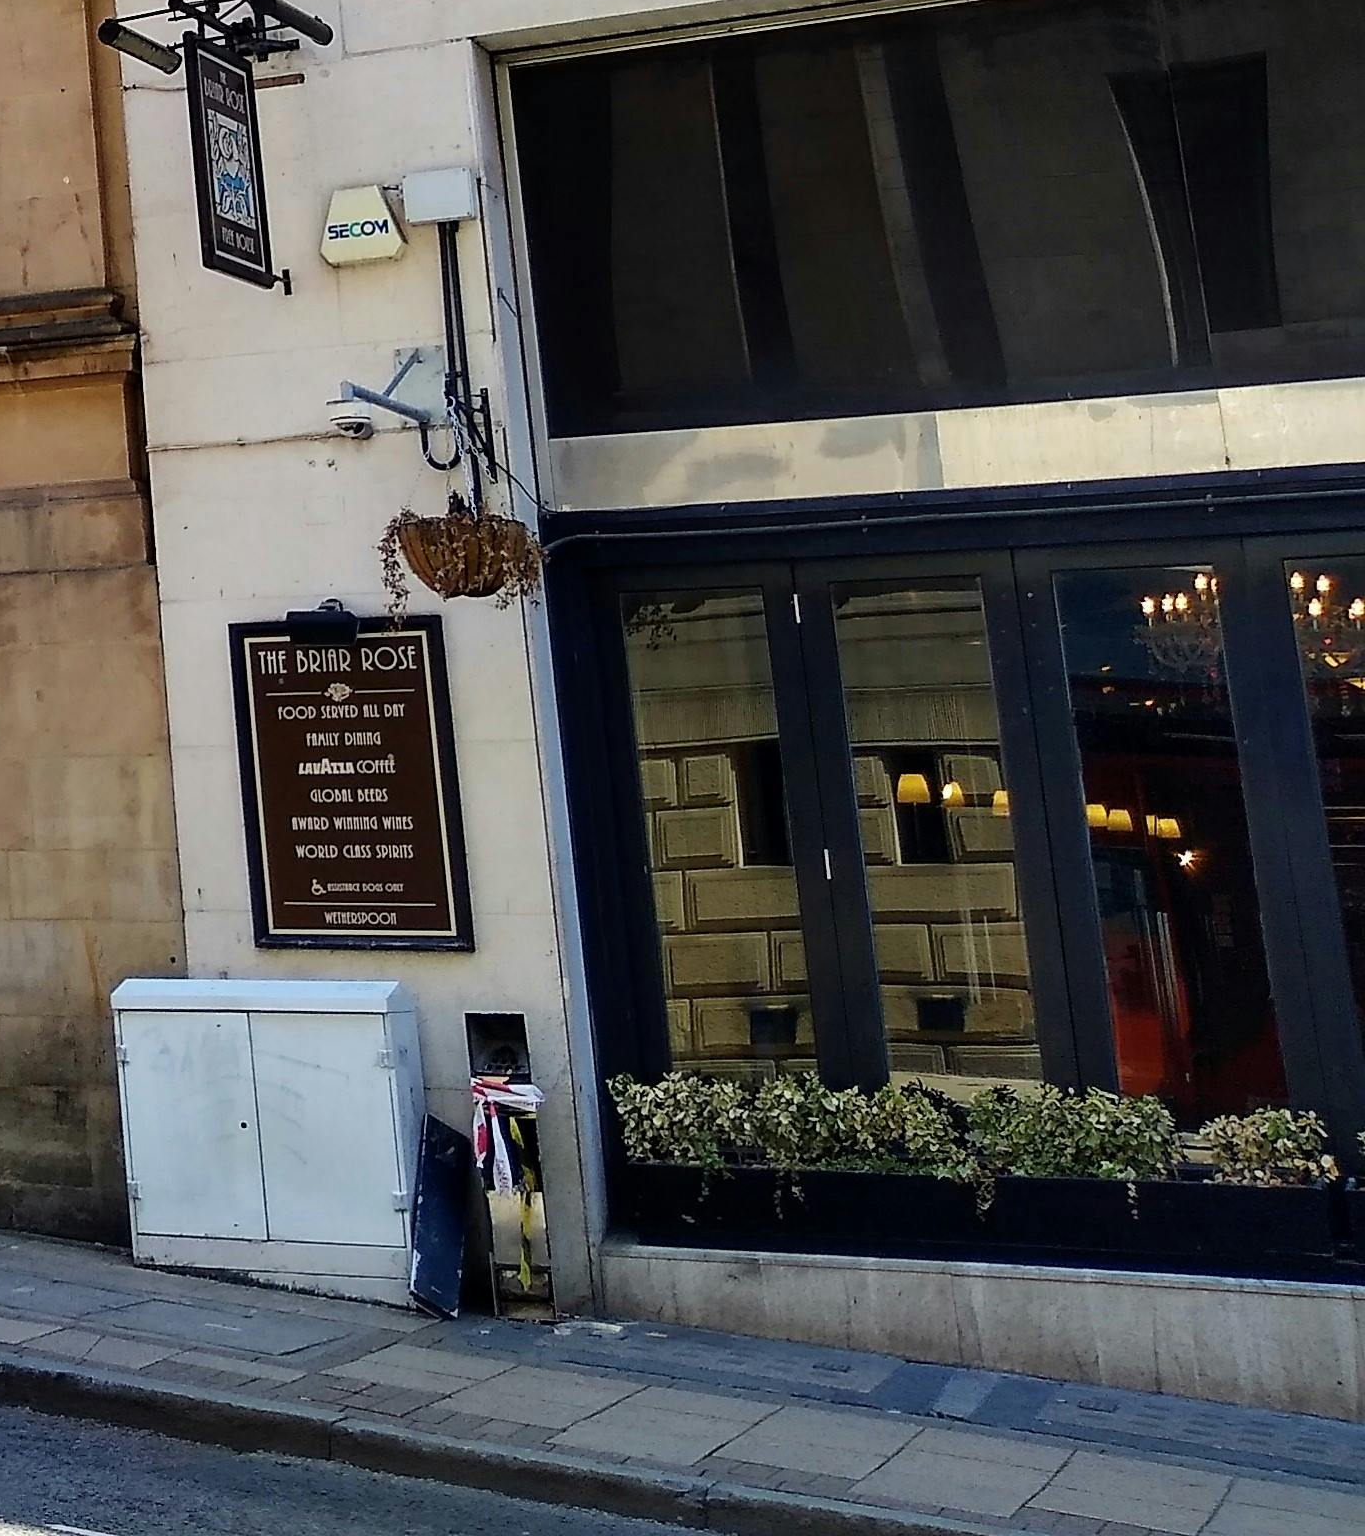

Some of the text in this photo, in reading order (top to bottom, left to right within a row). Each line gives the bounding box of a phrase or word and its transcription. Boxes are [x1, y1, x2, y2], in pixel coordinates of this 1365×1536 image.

[328, 219, 389, 240] SECOM
[257, 645, 418, 674] THE BRIAR ROSE
[277, 703, 405, 720] FOOD SERVED ALL DAY
[306, 731, 382, 747] FAMILY DINING
[298, 758, 396, 775] LAVAZZA COFFEE
[310, 788, 388, 803] GLOBAL BEERS
[291, 816, 414, 830] AWARD WINNING WINES
[295, 844, 414, 859] WORLD CLASS SPIRITS
[362, 882, 383, 893] DOGS
[384, 882, 404, 893] ONLY
[324, 911, 397, 925] WETHERSPOON
